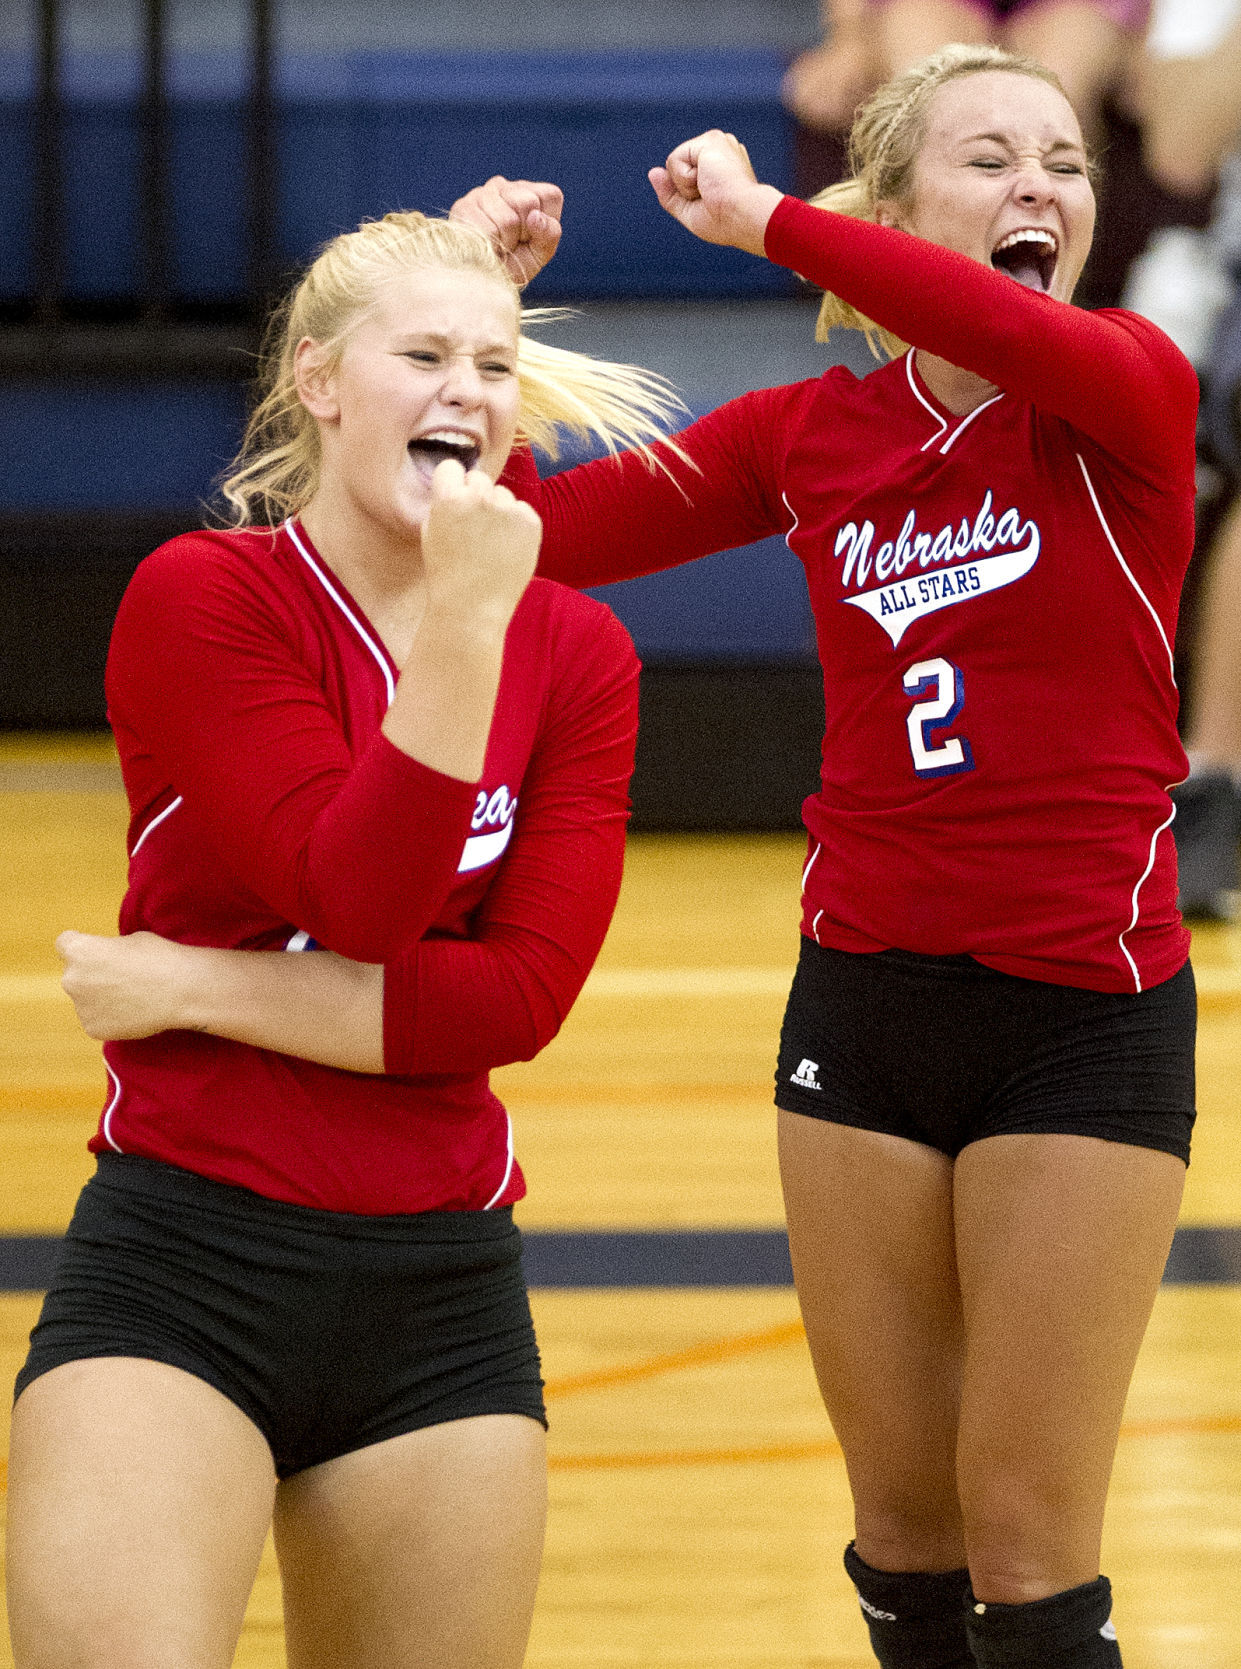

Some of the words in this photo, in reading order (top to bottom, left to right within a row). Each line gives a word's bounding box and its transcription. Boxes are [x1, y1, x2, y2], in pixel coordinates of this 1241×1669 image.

[834, 488, 1033, 588] Nebraska
[880, 585, 916, 616] ALL
[918, 567, 980, 603] STARS
[903, 656, 976, 779] 2
